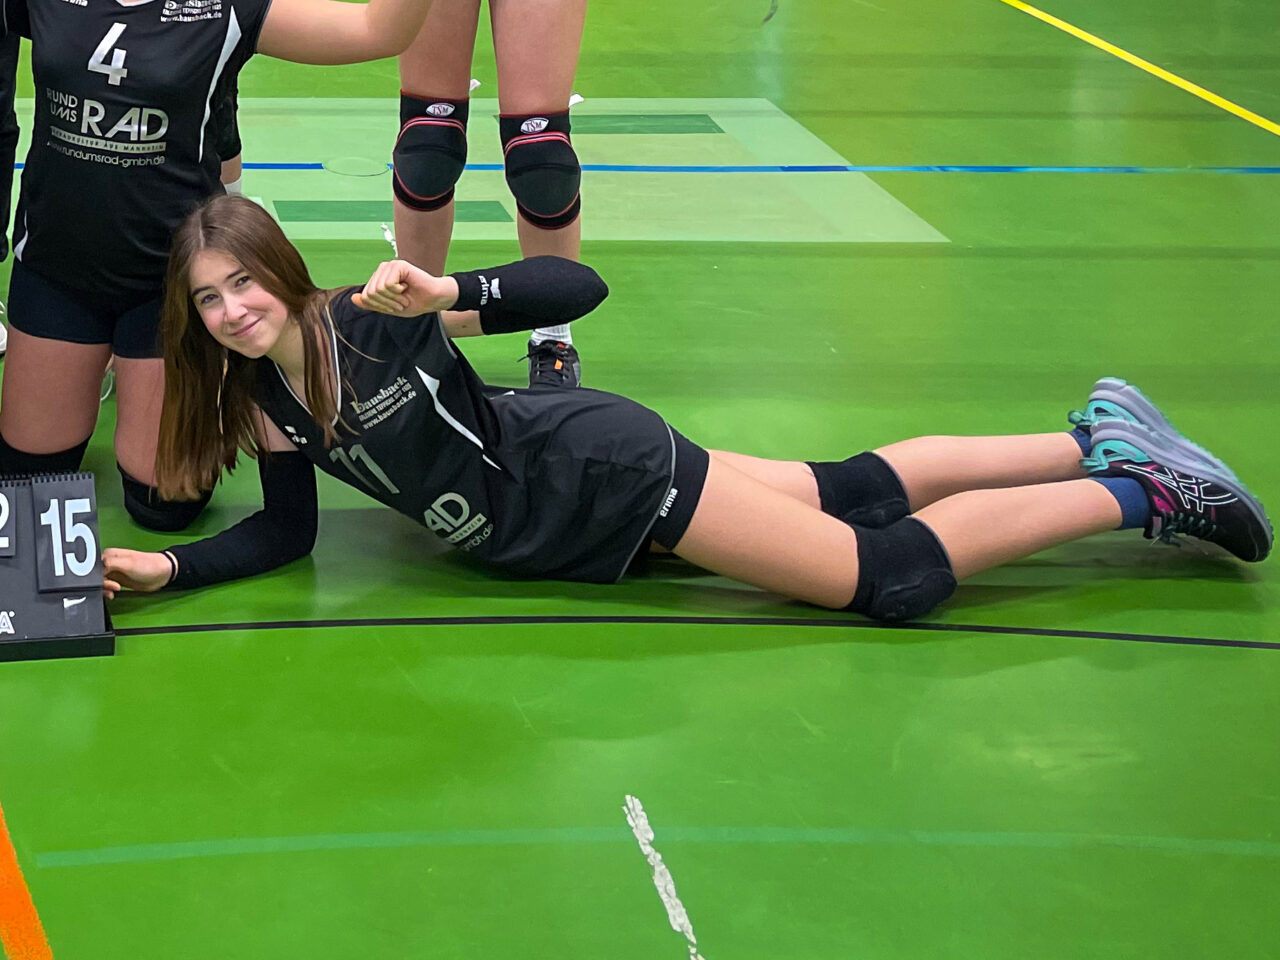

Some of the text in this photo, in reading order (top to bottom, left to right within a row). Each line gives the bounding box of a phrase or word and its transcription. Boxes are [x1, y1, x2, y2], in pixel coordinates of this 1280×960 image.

[87, 22, 128, 86] 4
[46, 87, 78, 108] RUND
[50, 102, 77, 123] UMS
[432, 105, 449, 116] TSM
[81, 99, 169, 141] RAD
[525, 120, 542, 133] TSM
[478, 275, 490, 306] erima
[349, 376, 408, 414] bausback
[362, 390, 417, 430] www.bausback.de
[328, 443, 401, 494] 11
[424, 492, 470, 533] AD
[660, 487, 679, 518] erima
[40, 498, 97, 577] 15
